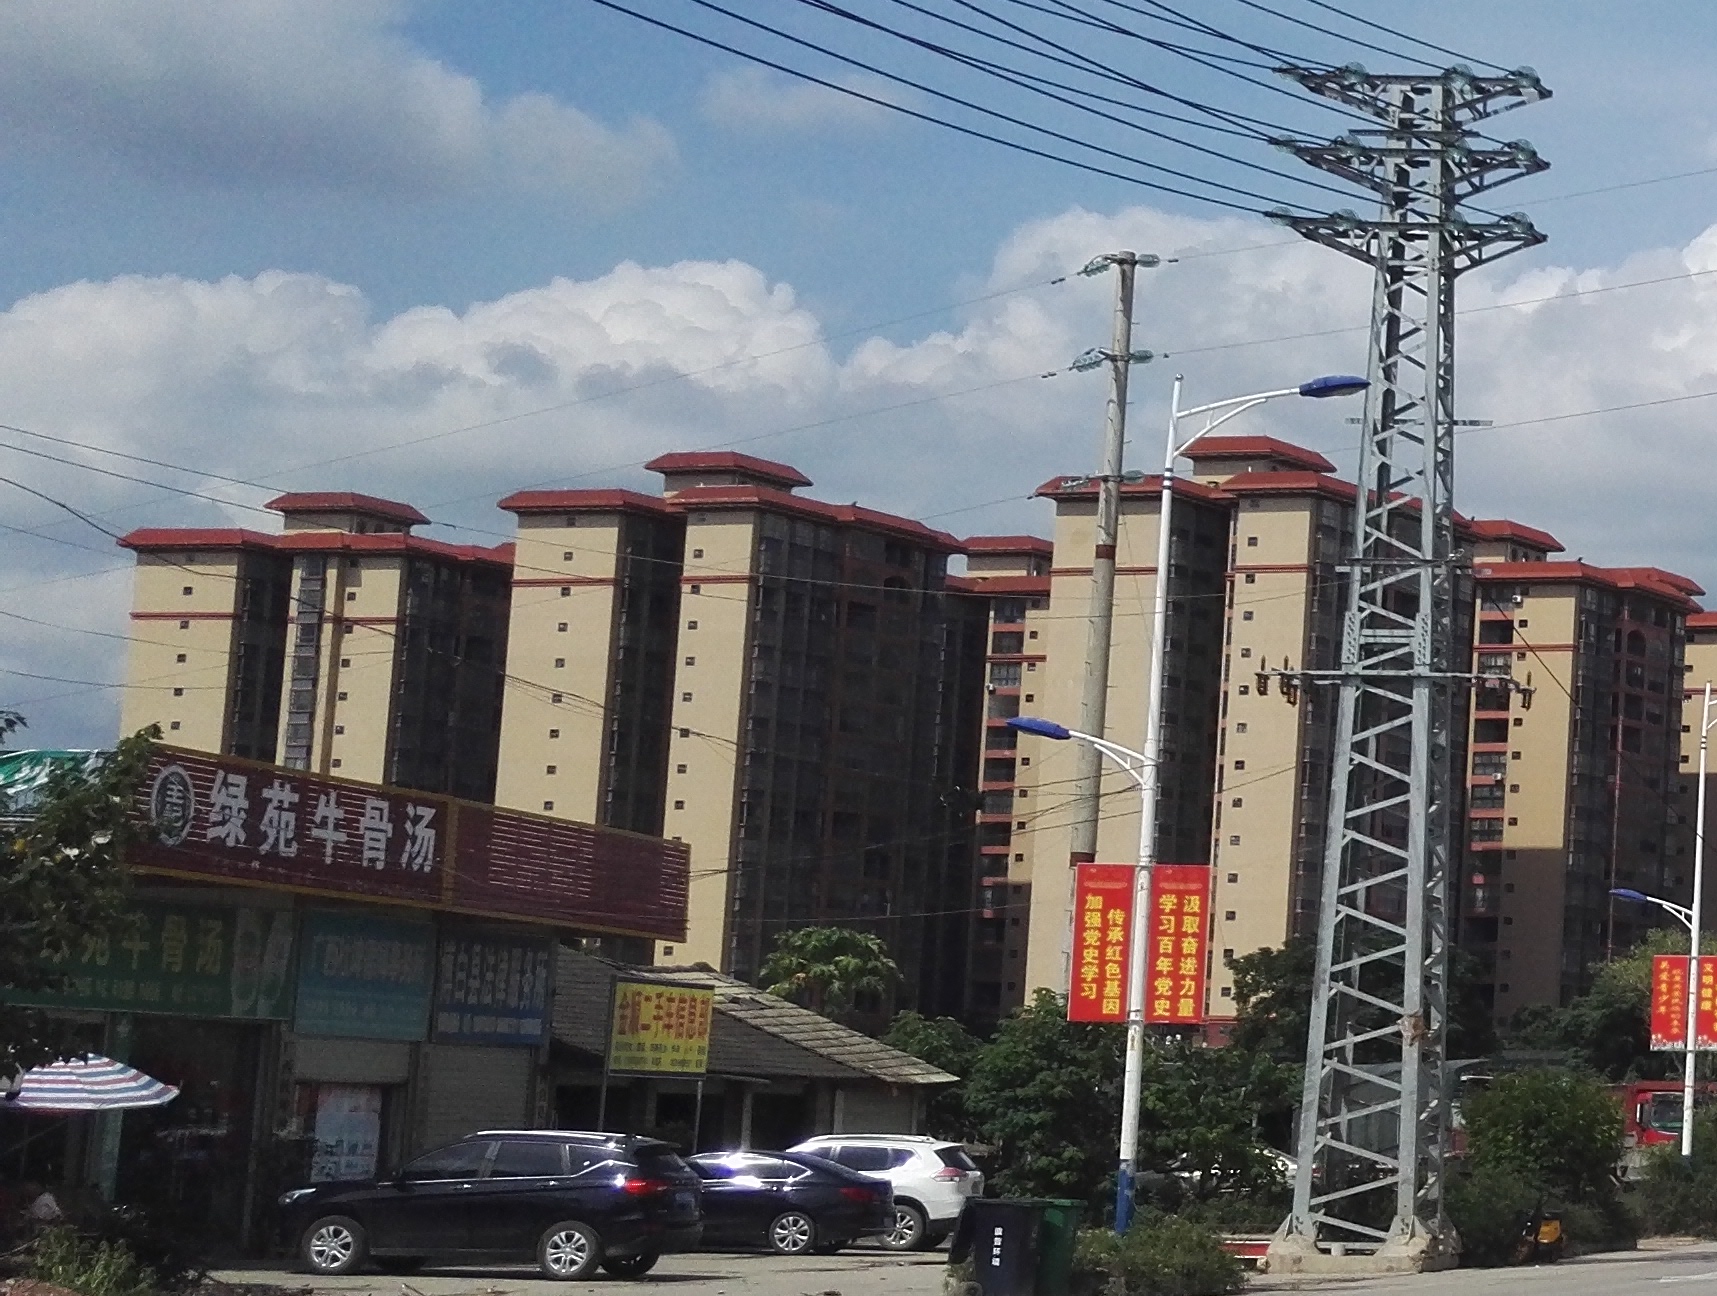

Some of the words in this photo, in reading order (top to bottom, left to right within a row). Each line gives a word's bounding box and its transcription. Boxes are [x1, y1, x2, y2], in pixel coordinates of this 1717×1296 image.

[206, 769, 437, 873] 绿苑牛骨汤
[1080, 892, 1103, 999] 加强党史学习
[1102, 908, 1126, 1015] 传承红色基因
[1153, 893, 1177, 1017] 学习百年党史
[1176, 894, 1201, 1017] 汲取奋进力量
